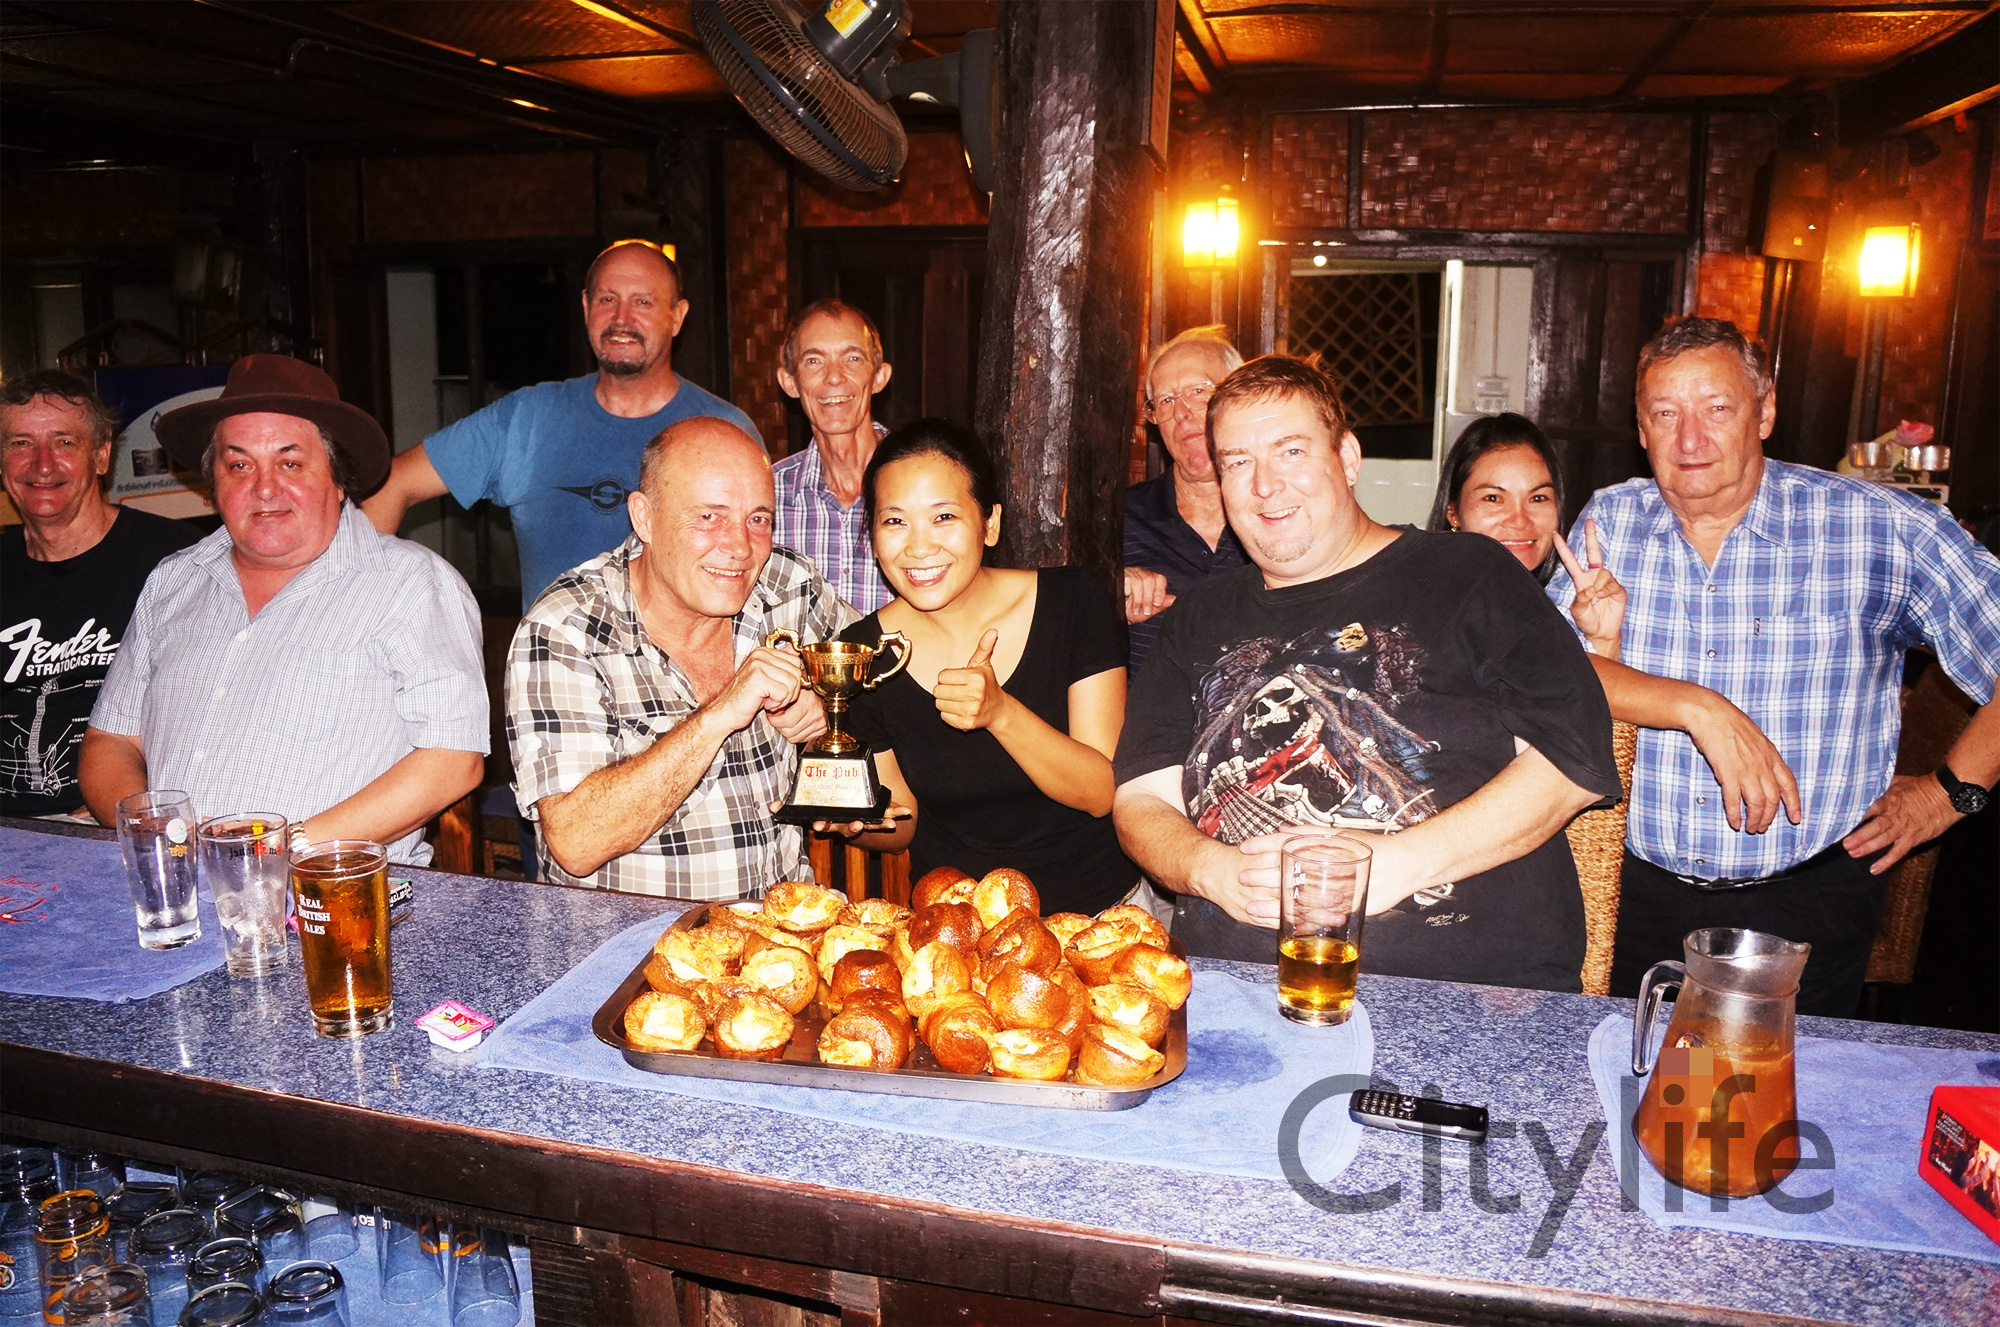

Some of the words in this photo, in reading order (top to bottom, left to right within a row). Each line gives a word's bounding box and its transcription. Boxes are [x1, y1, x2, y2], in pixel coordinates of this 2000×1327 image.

[0, 618, 121, 683] Fender
[804, 766, 827, 779] The
[833, 767, 858, 779] Pub
[298, 893, 324, 910] REAL
[297, 904, 331, 922] BRITISH
[303, 920, 326, 935] ALES
